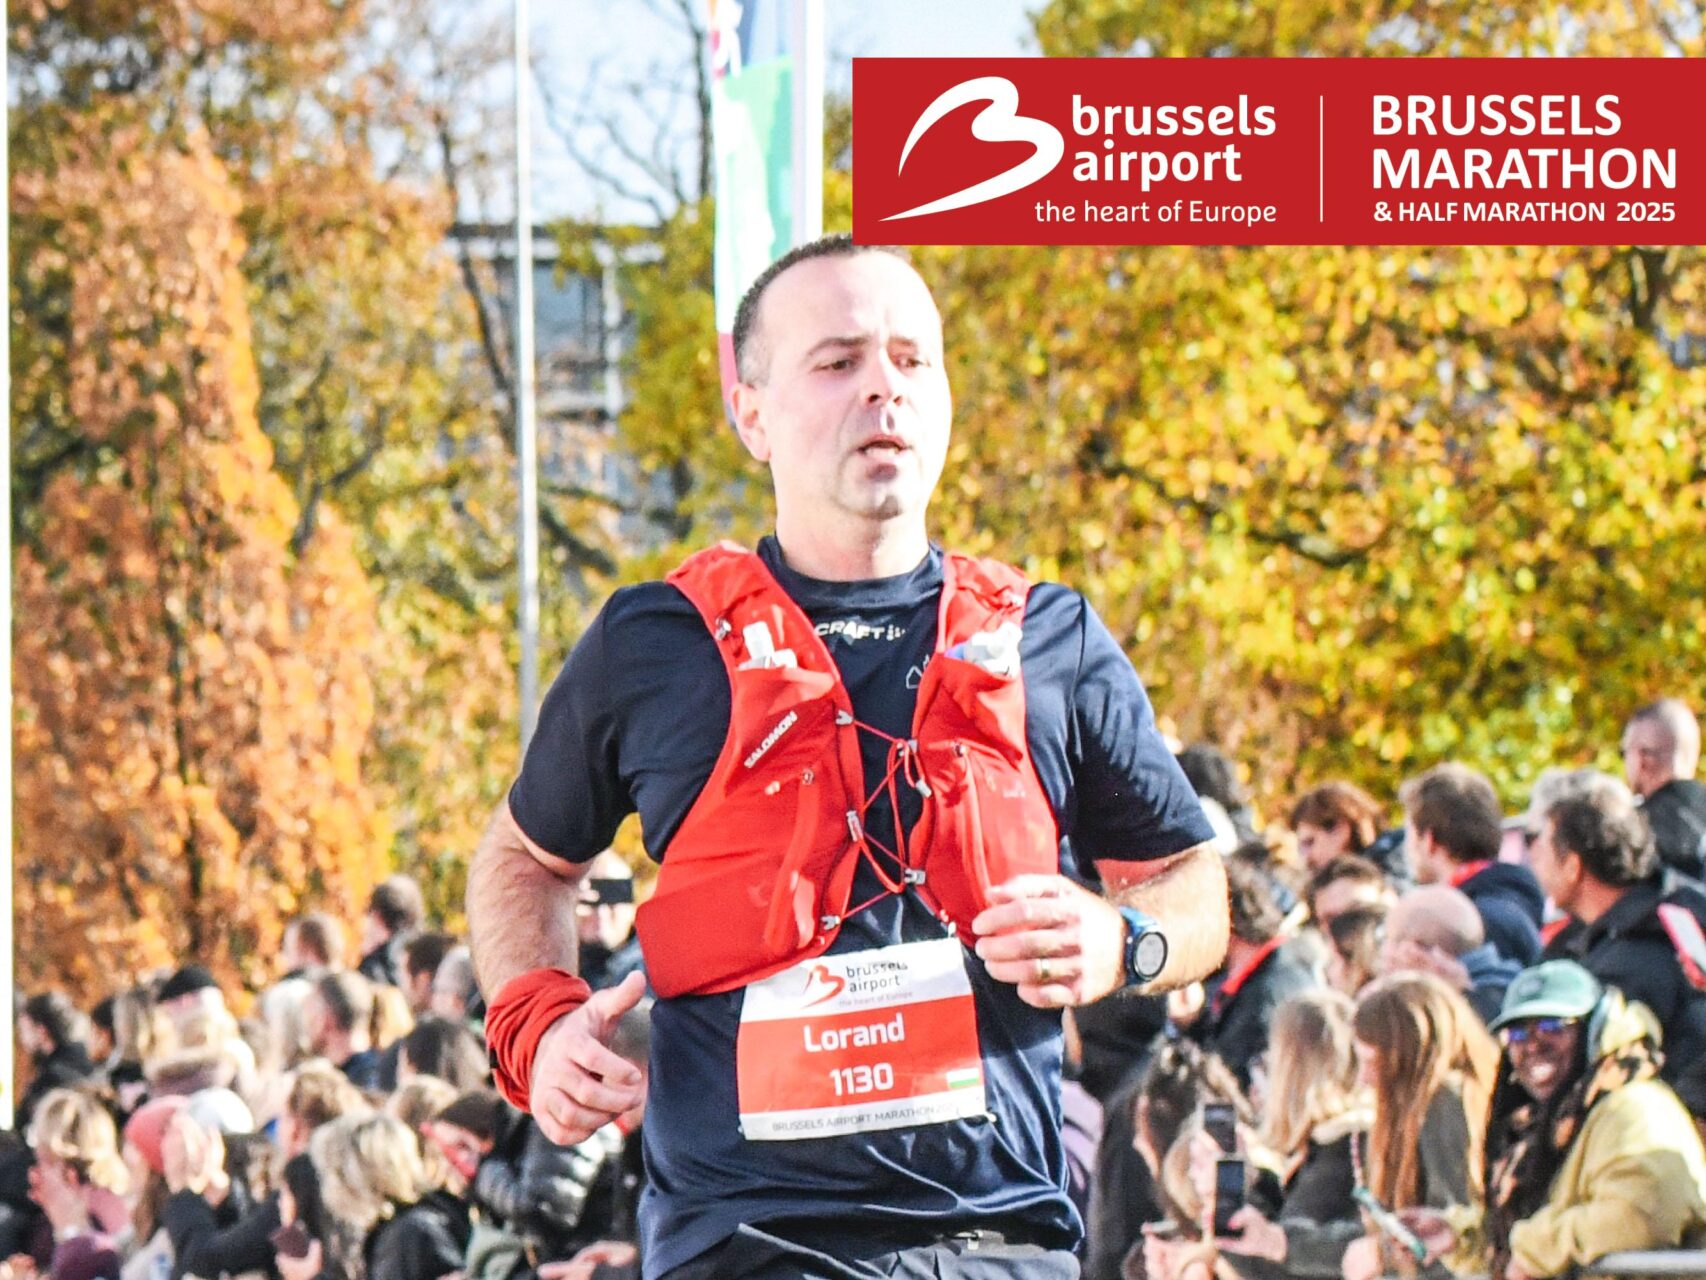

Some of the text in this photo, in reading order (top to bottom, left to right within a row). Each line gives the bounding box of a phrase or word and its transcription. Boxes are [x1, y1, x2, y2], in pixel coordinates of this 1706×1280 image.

[814, 621, 885, 640] CRAFT
[743, 710, 798, 769] SALOMON
[846, 962, 908, 978] brussels
[850, 974, 901, 993] airport
[803, 1013, 905, 1051] Lorand
[828, 1062, 894, 1096] 1130
[772, 1117, 825, 1133] BRUSSELS
[827, 1113, 871, 1128] AIRPORT
[874, 1105, 935, 1123] MARATHON
